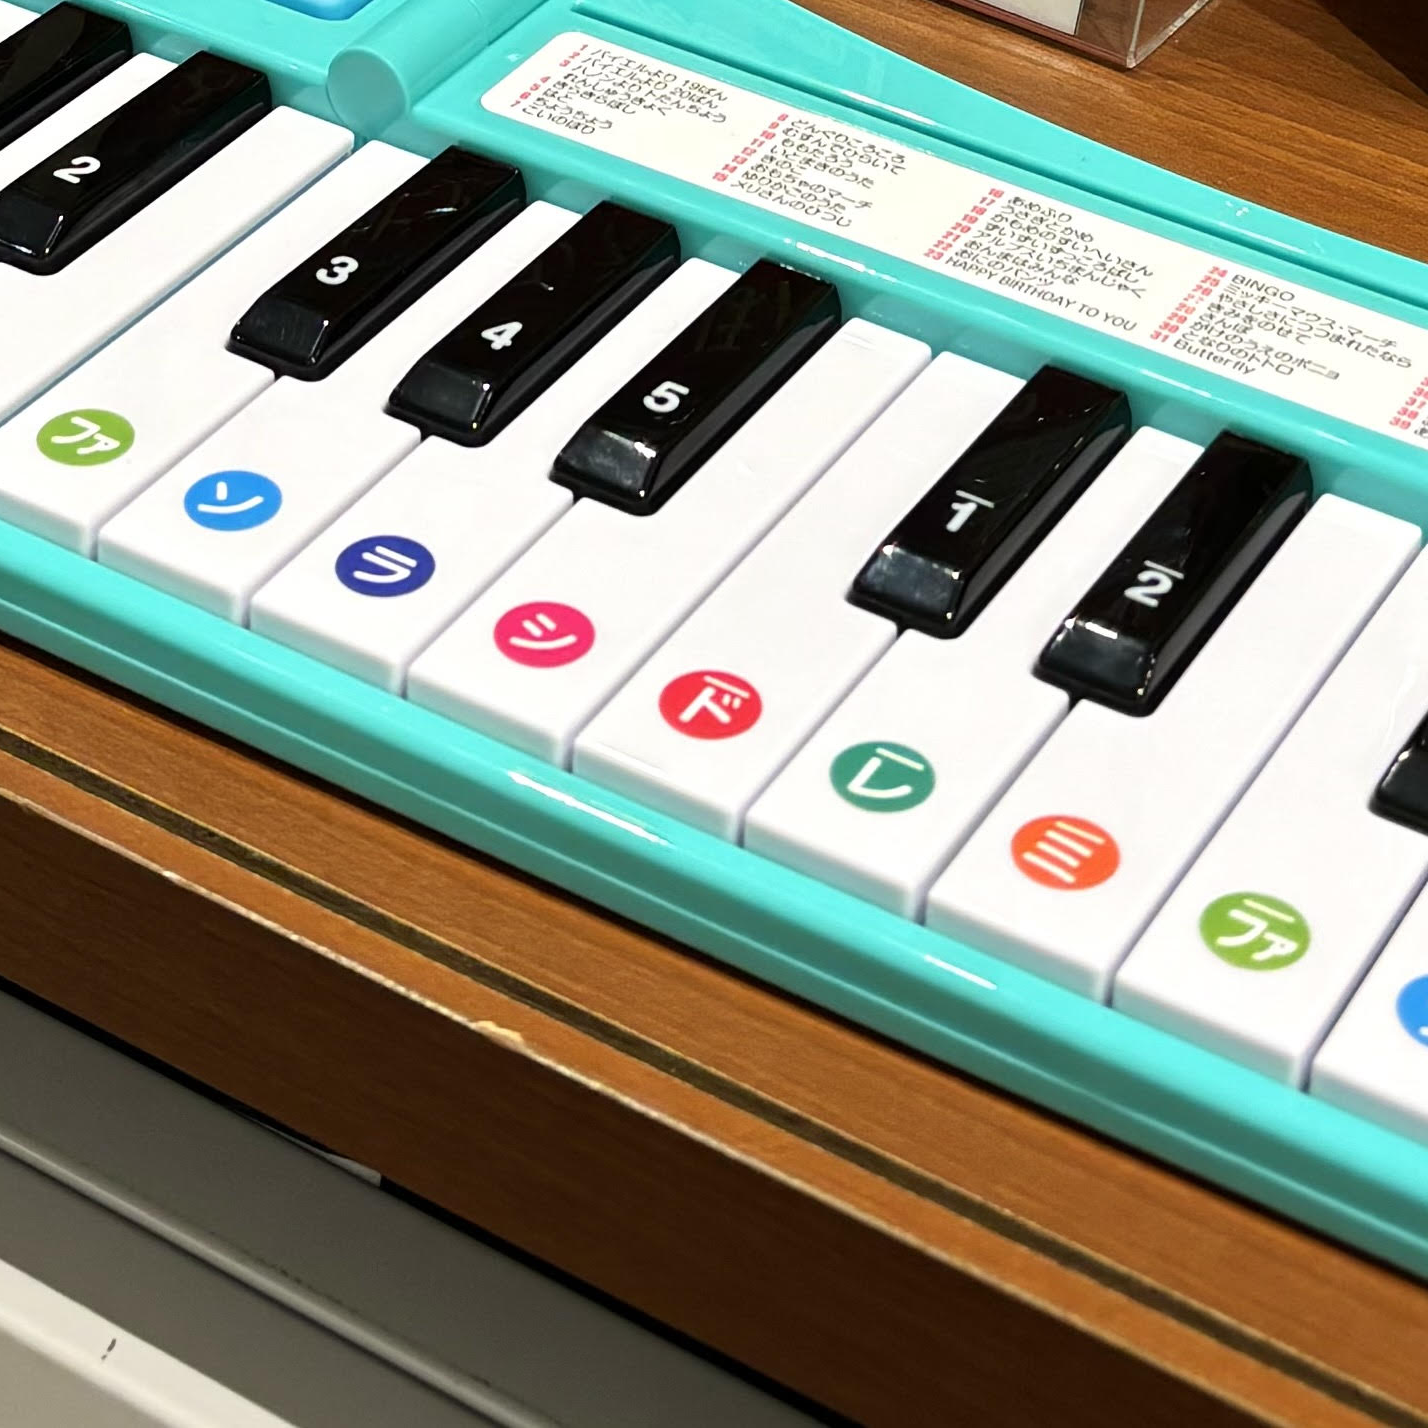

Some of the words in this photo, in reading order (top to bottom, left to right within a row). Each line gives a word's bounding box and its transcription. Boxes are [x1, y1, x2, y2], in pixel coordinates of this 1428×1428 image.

[53, 156, 102, 184] 2
[316, 255, 359, 285] 3
[945, 255, 1001, 280] HAPPY
[1103, 312, 1137, 332] YOU
[1230, 274, 1295, 302] BINGO
[480, 321, 524, 350] 4
[642, 380, 690, 413] 5
[945, 501, 978, 532] 1
[1124, 570, 1174, 608] 2
